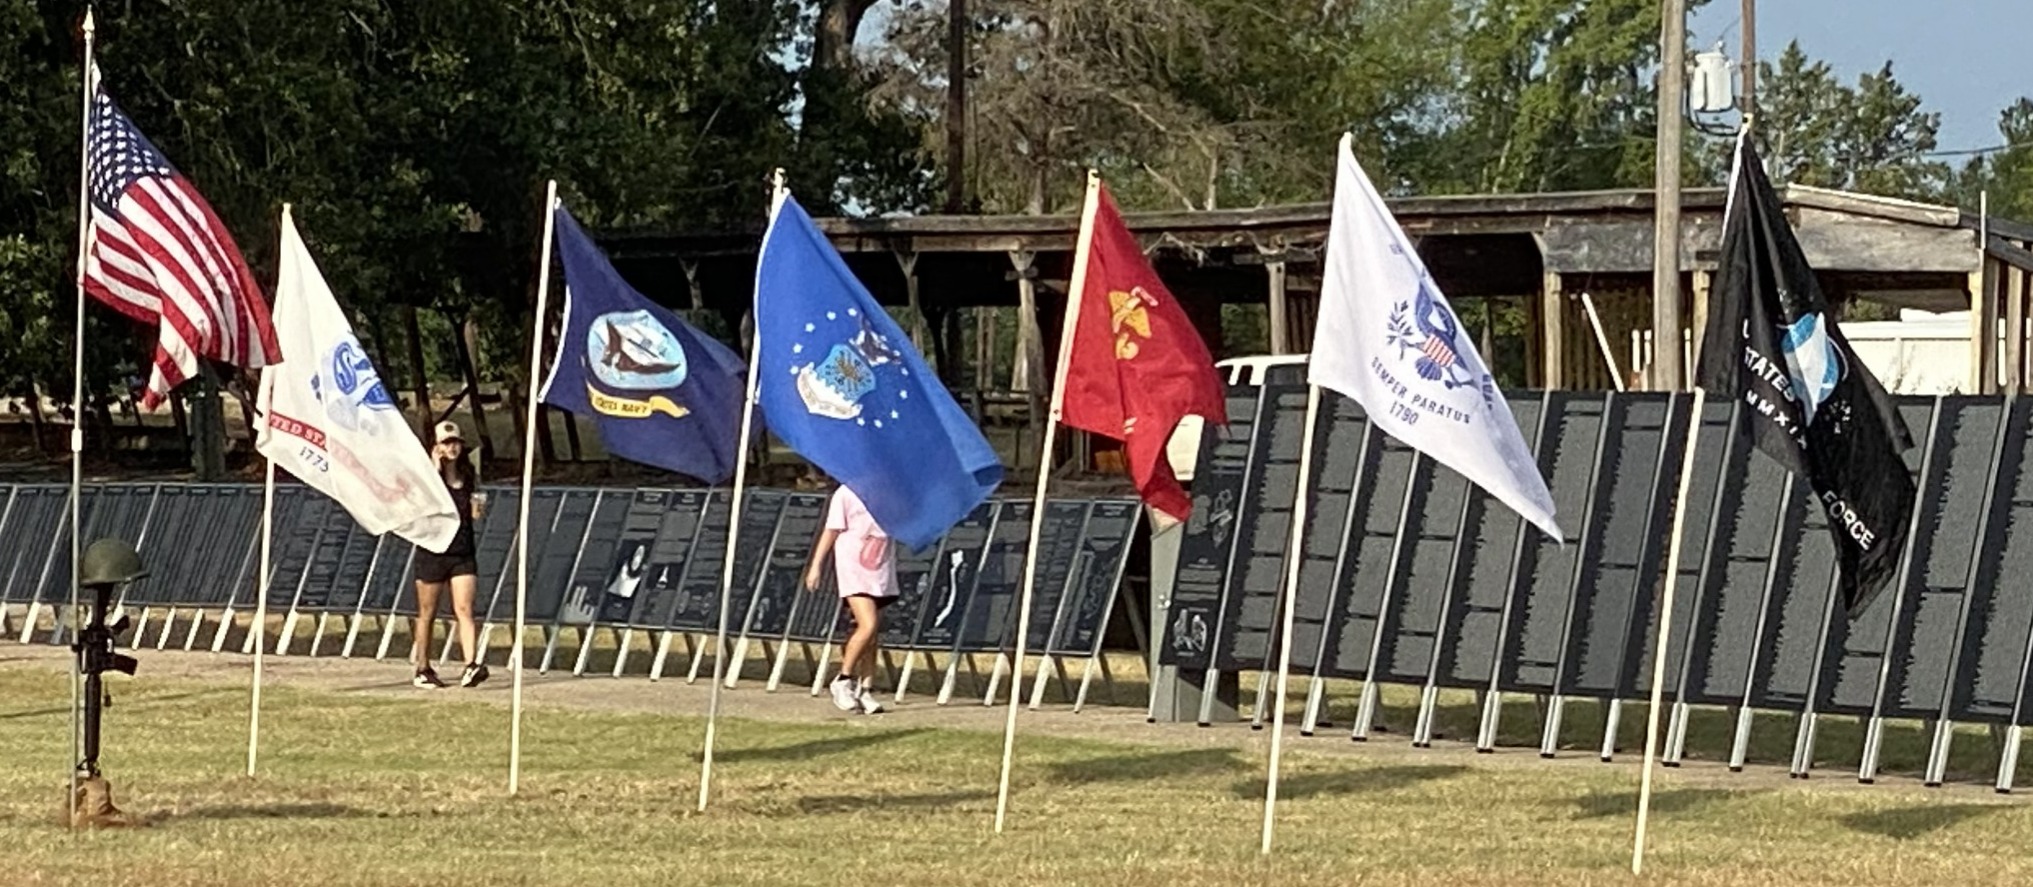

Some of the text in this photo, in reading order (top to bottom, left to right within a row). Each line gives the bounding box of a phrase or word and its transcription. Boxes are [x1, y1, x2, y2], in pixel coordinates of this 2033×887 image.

[1371, 356, 1471, 424] SEMPER PARATUS
[1389, 400, 1419, 425] 1790
[1822, 490, 1875, 551] FORCE
